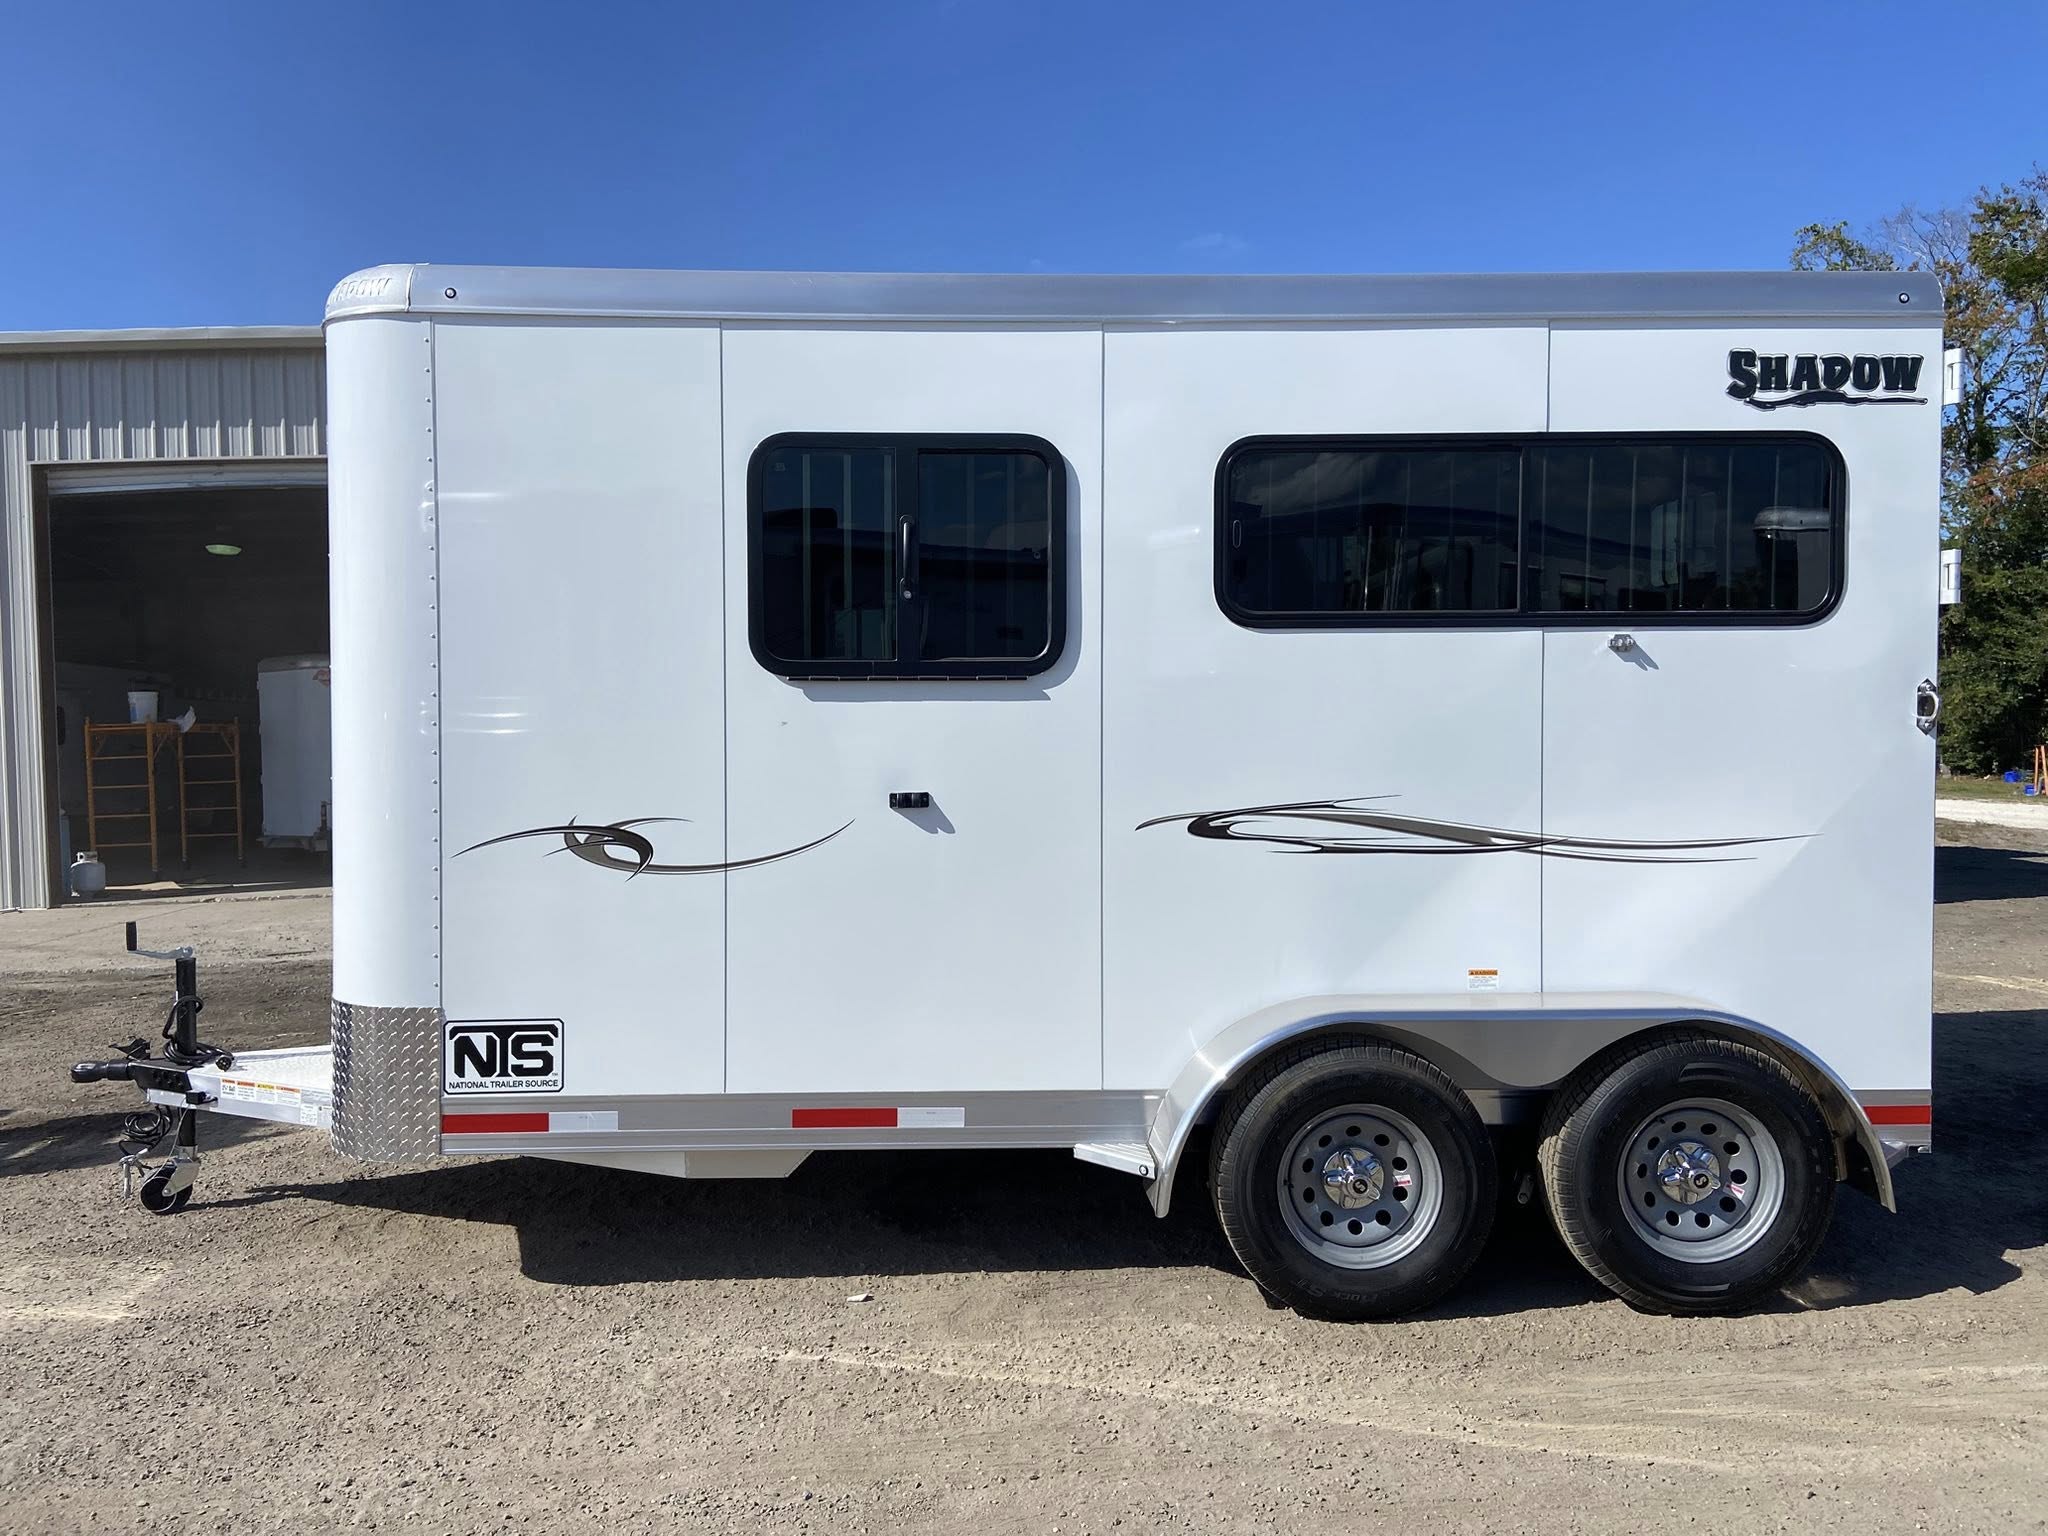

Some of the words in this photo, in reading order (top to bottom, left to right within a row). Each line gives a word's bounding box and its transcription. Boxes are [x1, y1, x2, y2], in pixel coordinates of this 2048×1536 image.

[1726, 348, 1925, 401] SHADOW
[449, 1024, 559, 1078] NTS
[449, 1080, 489, 1089] NATIONAL
[490, 1079, 524, 1088] TRAILER
[525, 1079, 559, 1087] SOURCE
